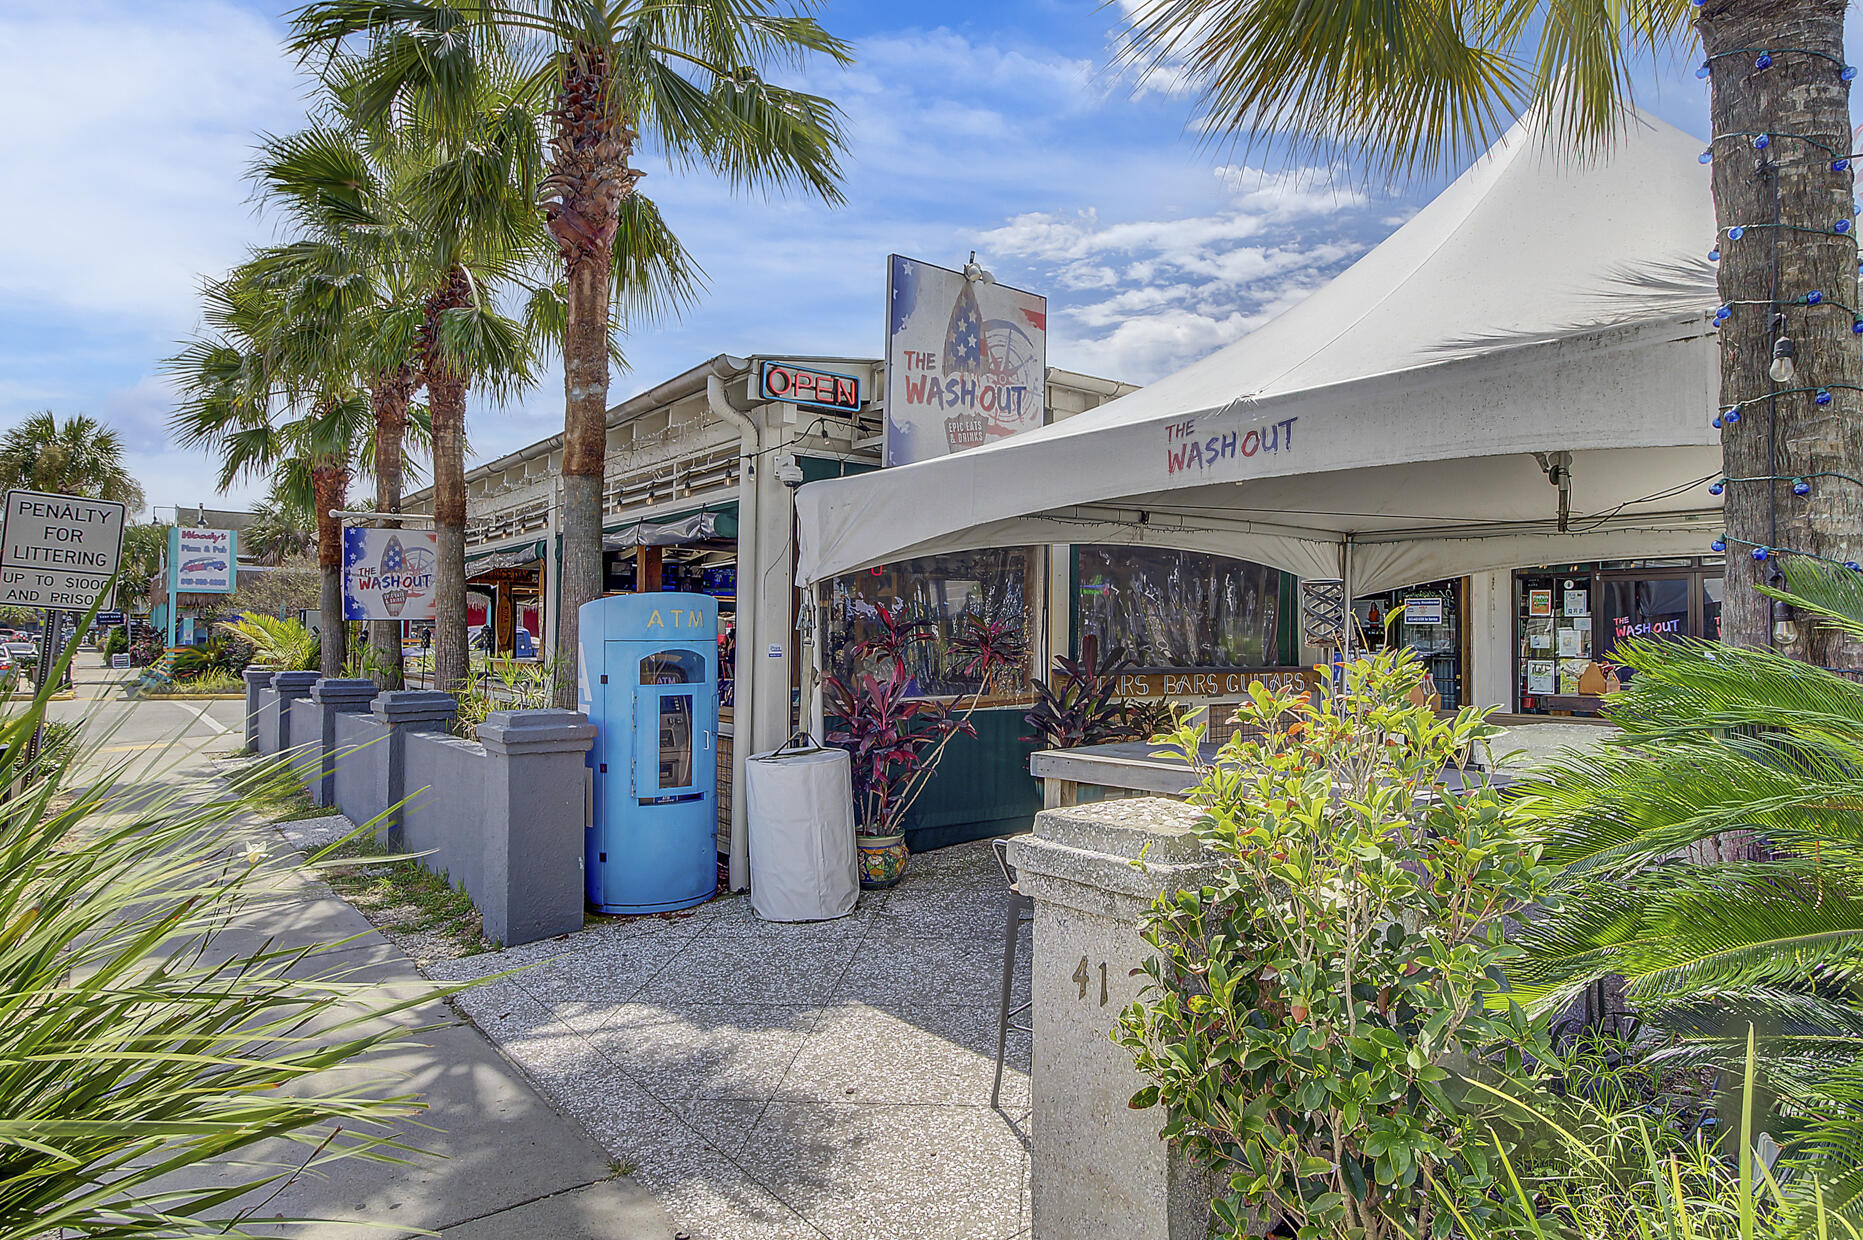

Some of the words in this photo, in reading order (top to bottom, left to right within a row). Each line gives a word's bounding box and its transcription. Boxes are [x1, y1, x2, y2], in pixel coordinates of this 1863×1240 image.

[904, 351, 936, 371] THE
[768, 368, 856, 405] OPEN
[905, 375, 1027, 415] WASHOUT
[949, 422, 964, 432] EPIC
[965, 421, 982, 431] EATS
[1165, 419, 1195, 442] THE
[958, 432, 983, 443] DRINKS
[1168, 416, 1298, 474] WASHOUT
[19, 502, 112, 524] PENALTY
[44, 526, 83, 543] FOR
[14, 545, 107, 567] LITTERING
[3, 572, 25, 583] UP
[36, 575, 54, 586] TO
[359, 567, 376, 577] THE
[359, 574, 432, 590] WASHOUT
[6, 589, 39, 601] AND
[50, 592, 98, 605] PRISO
[646, 609, 704, 628] ATM
[1613, 616, 1629, 625] THE
[1616, 619, 1680, 637] WASHOUT
[657, 676, 676, 685] ATM
[1164, 673, 1218, 694] BARS
[1072, 955, 1108, 1007] 41
